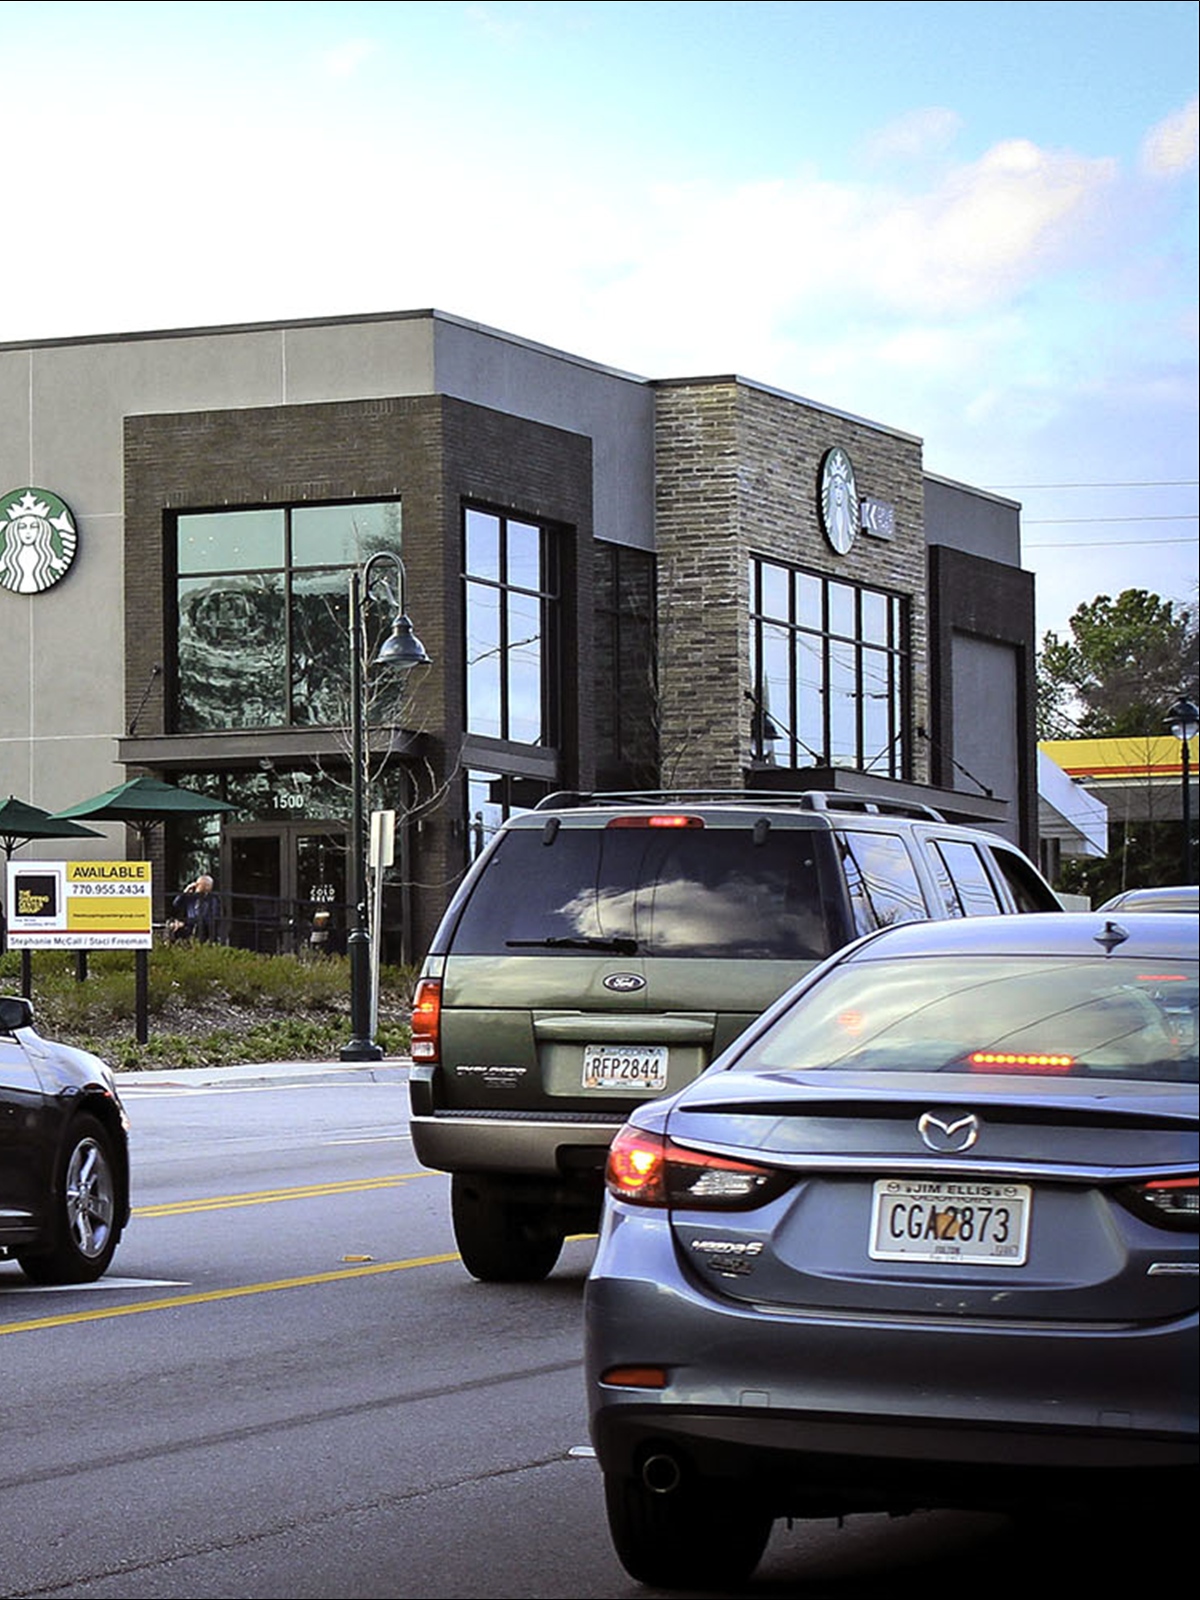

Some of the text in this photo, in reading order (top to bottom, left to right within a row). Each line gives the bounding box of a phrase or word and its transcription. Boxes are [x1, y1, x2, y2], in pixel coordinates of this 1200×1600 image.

[272, 795, 304, 808] 1500
[73, 867, 144, 878] AVAILABLE
[73, 885, 145, 895] 770.955.2434
[10, 937, 51, 945] Stephanie
[54, 937, 82, 945] McCall
[112, 937, 148, 945] Freeman
[592, 1058, 659, 1079] RFP2844
[912, 1185, 991, 1196] JIM ELLIS
[890, 1203, 1009, 1243] CGA2873
